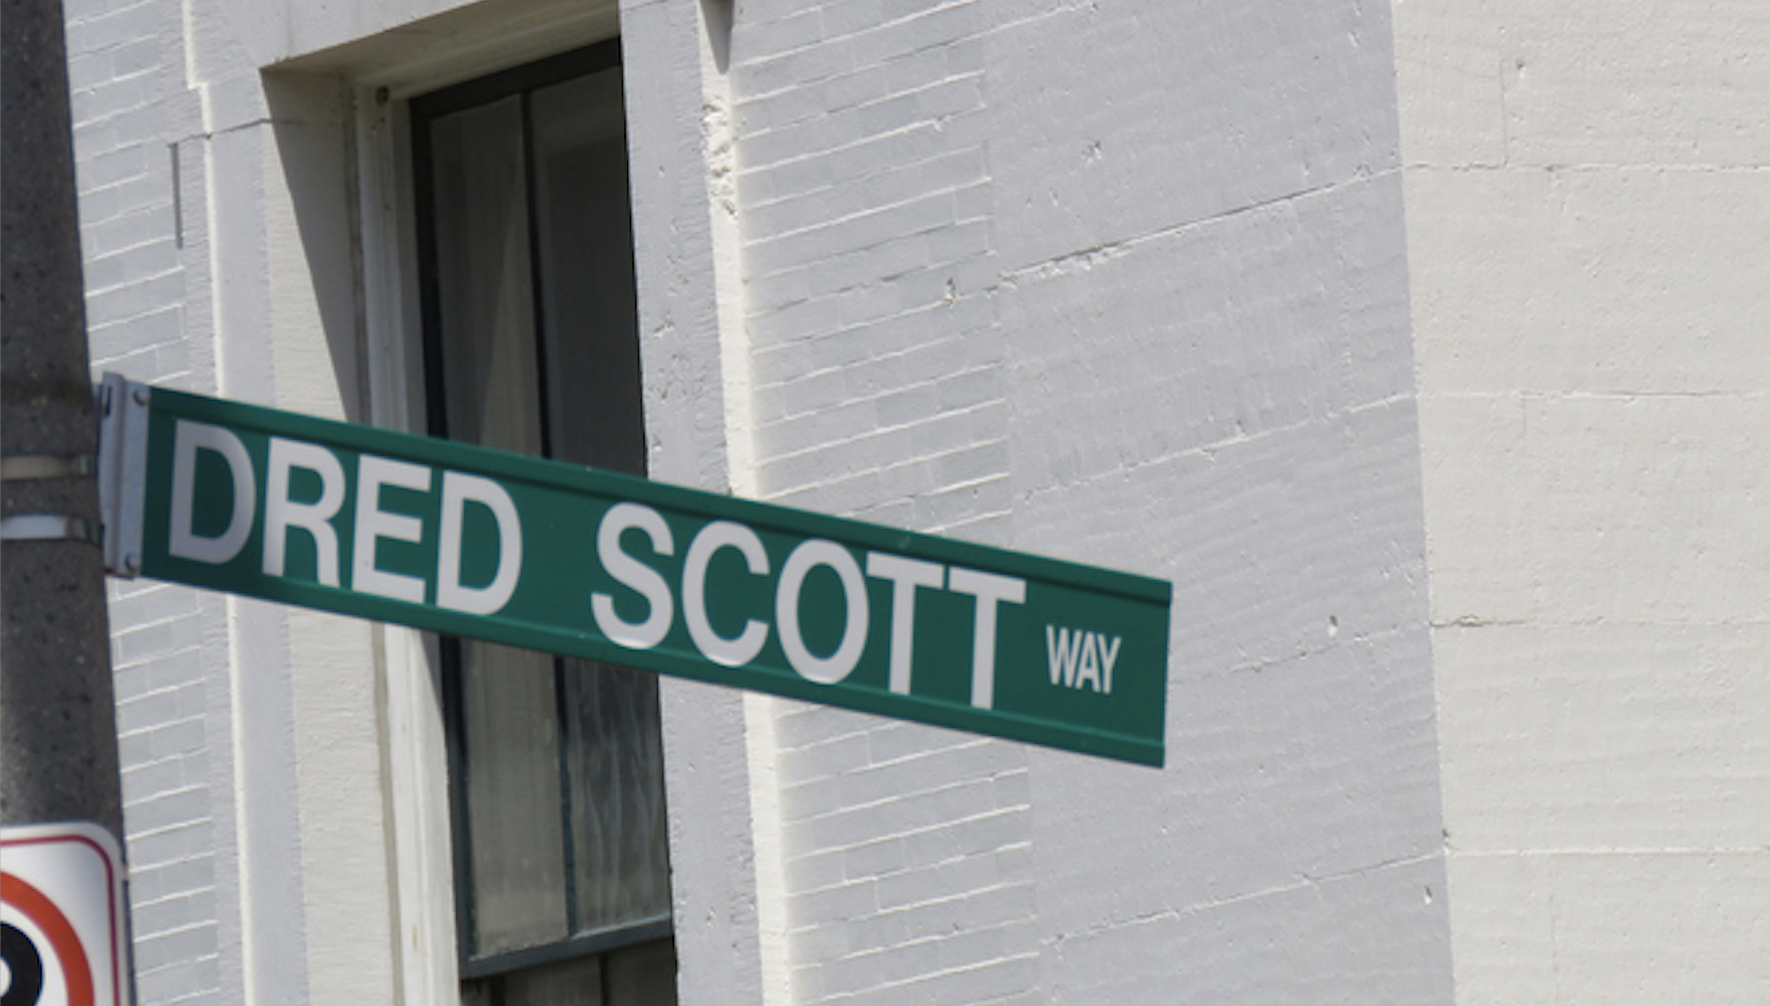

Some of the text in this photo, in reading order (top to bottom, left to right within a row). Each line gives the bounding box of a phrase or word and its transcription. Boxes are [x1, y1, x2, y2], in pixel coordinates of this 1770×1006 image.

[168, 419, 1122, 710] DRED SCOTT WAY
